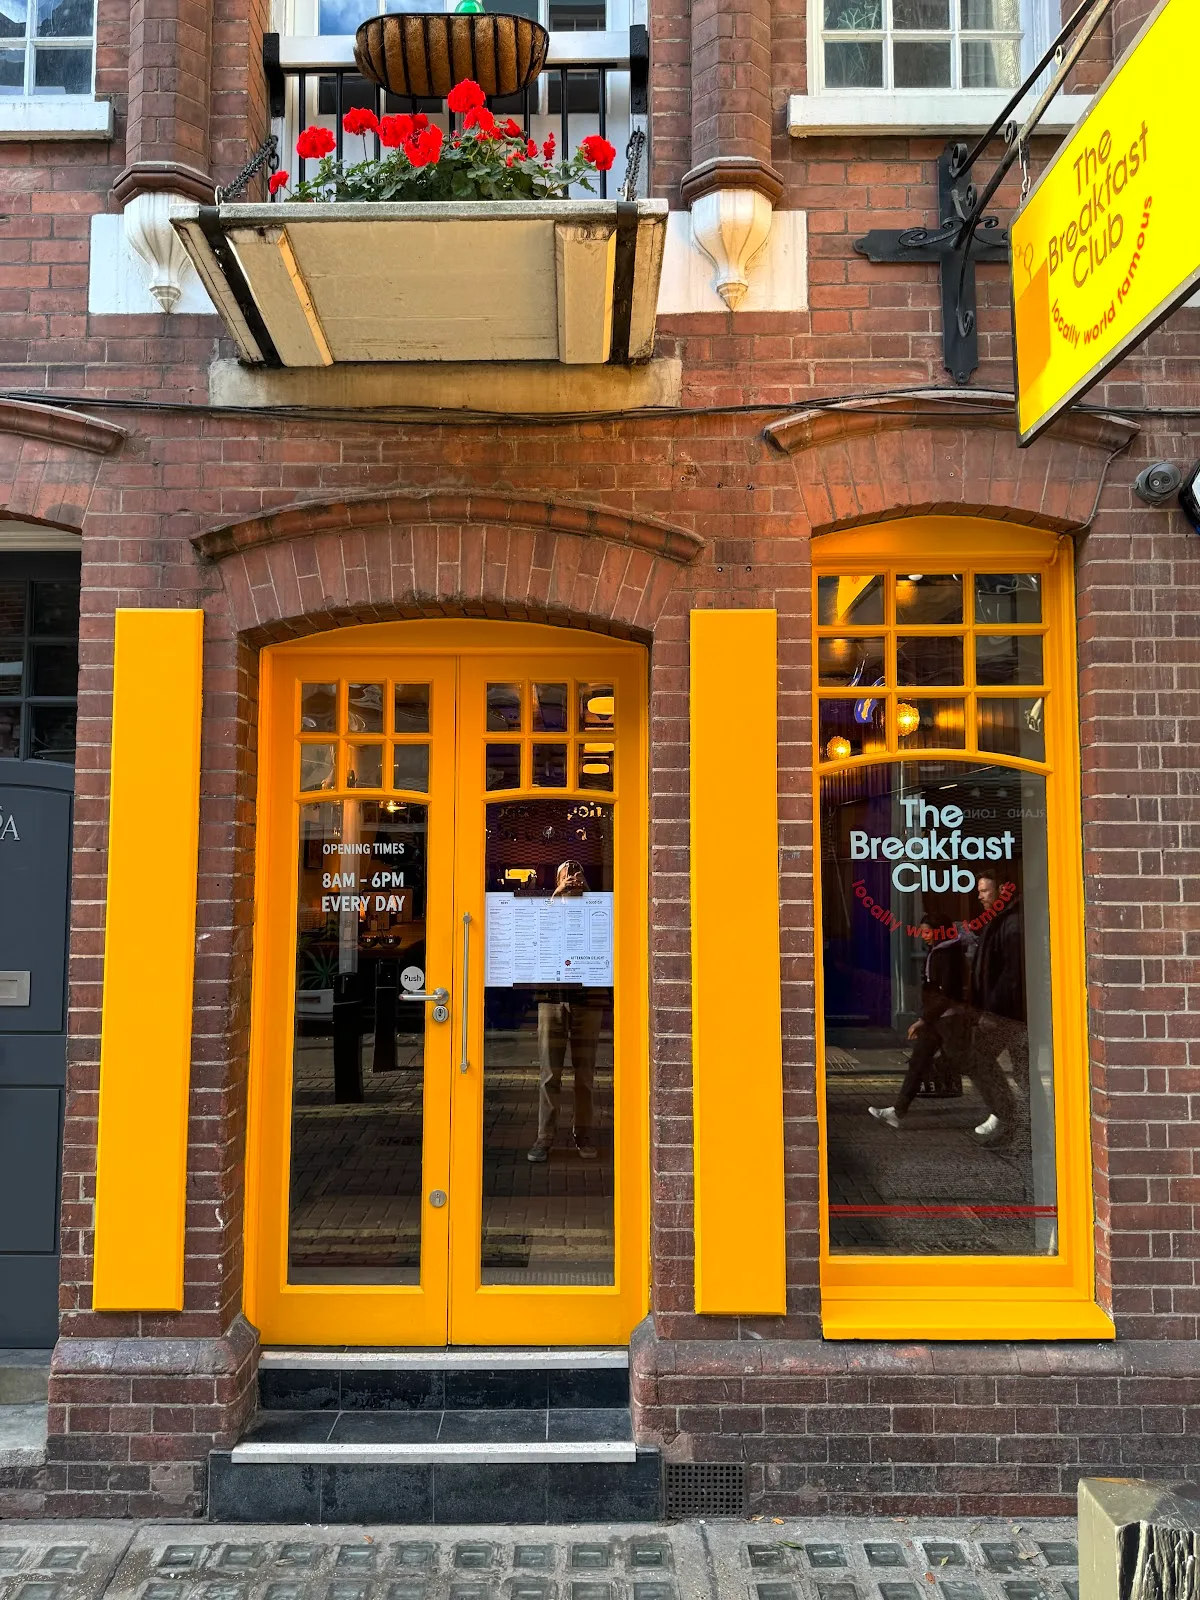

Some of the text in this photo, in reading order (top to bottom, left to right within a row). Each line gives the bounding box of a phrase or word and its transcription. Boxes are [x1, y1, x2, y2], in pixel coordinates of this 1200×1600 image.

[1073, 129, 1112, 197] The
[1048, 120, 1149, 277] Breakfast
[1072, 212, 1124, 288] Club
[1051, 195, 1153, 349] locally world famous
[900, 799, 964, 829] The
[322, 843, 405, 855] OPENING TIMES
[850, 830, 1016, 860] Breakfast
[322, 872, 355, 888] 8AM
[371, 872, 405, 888] 6PM
[891, 862, 976, 893] Club
[321, 895, 406, 912] EVERY DAY
[852, 879, 1017, 941] locally world famous
[403, 974, 422, 982] Push
